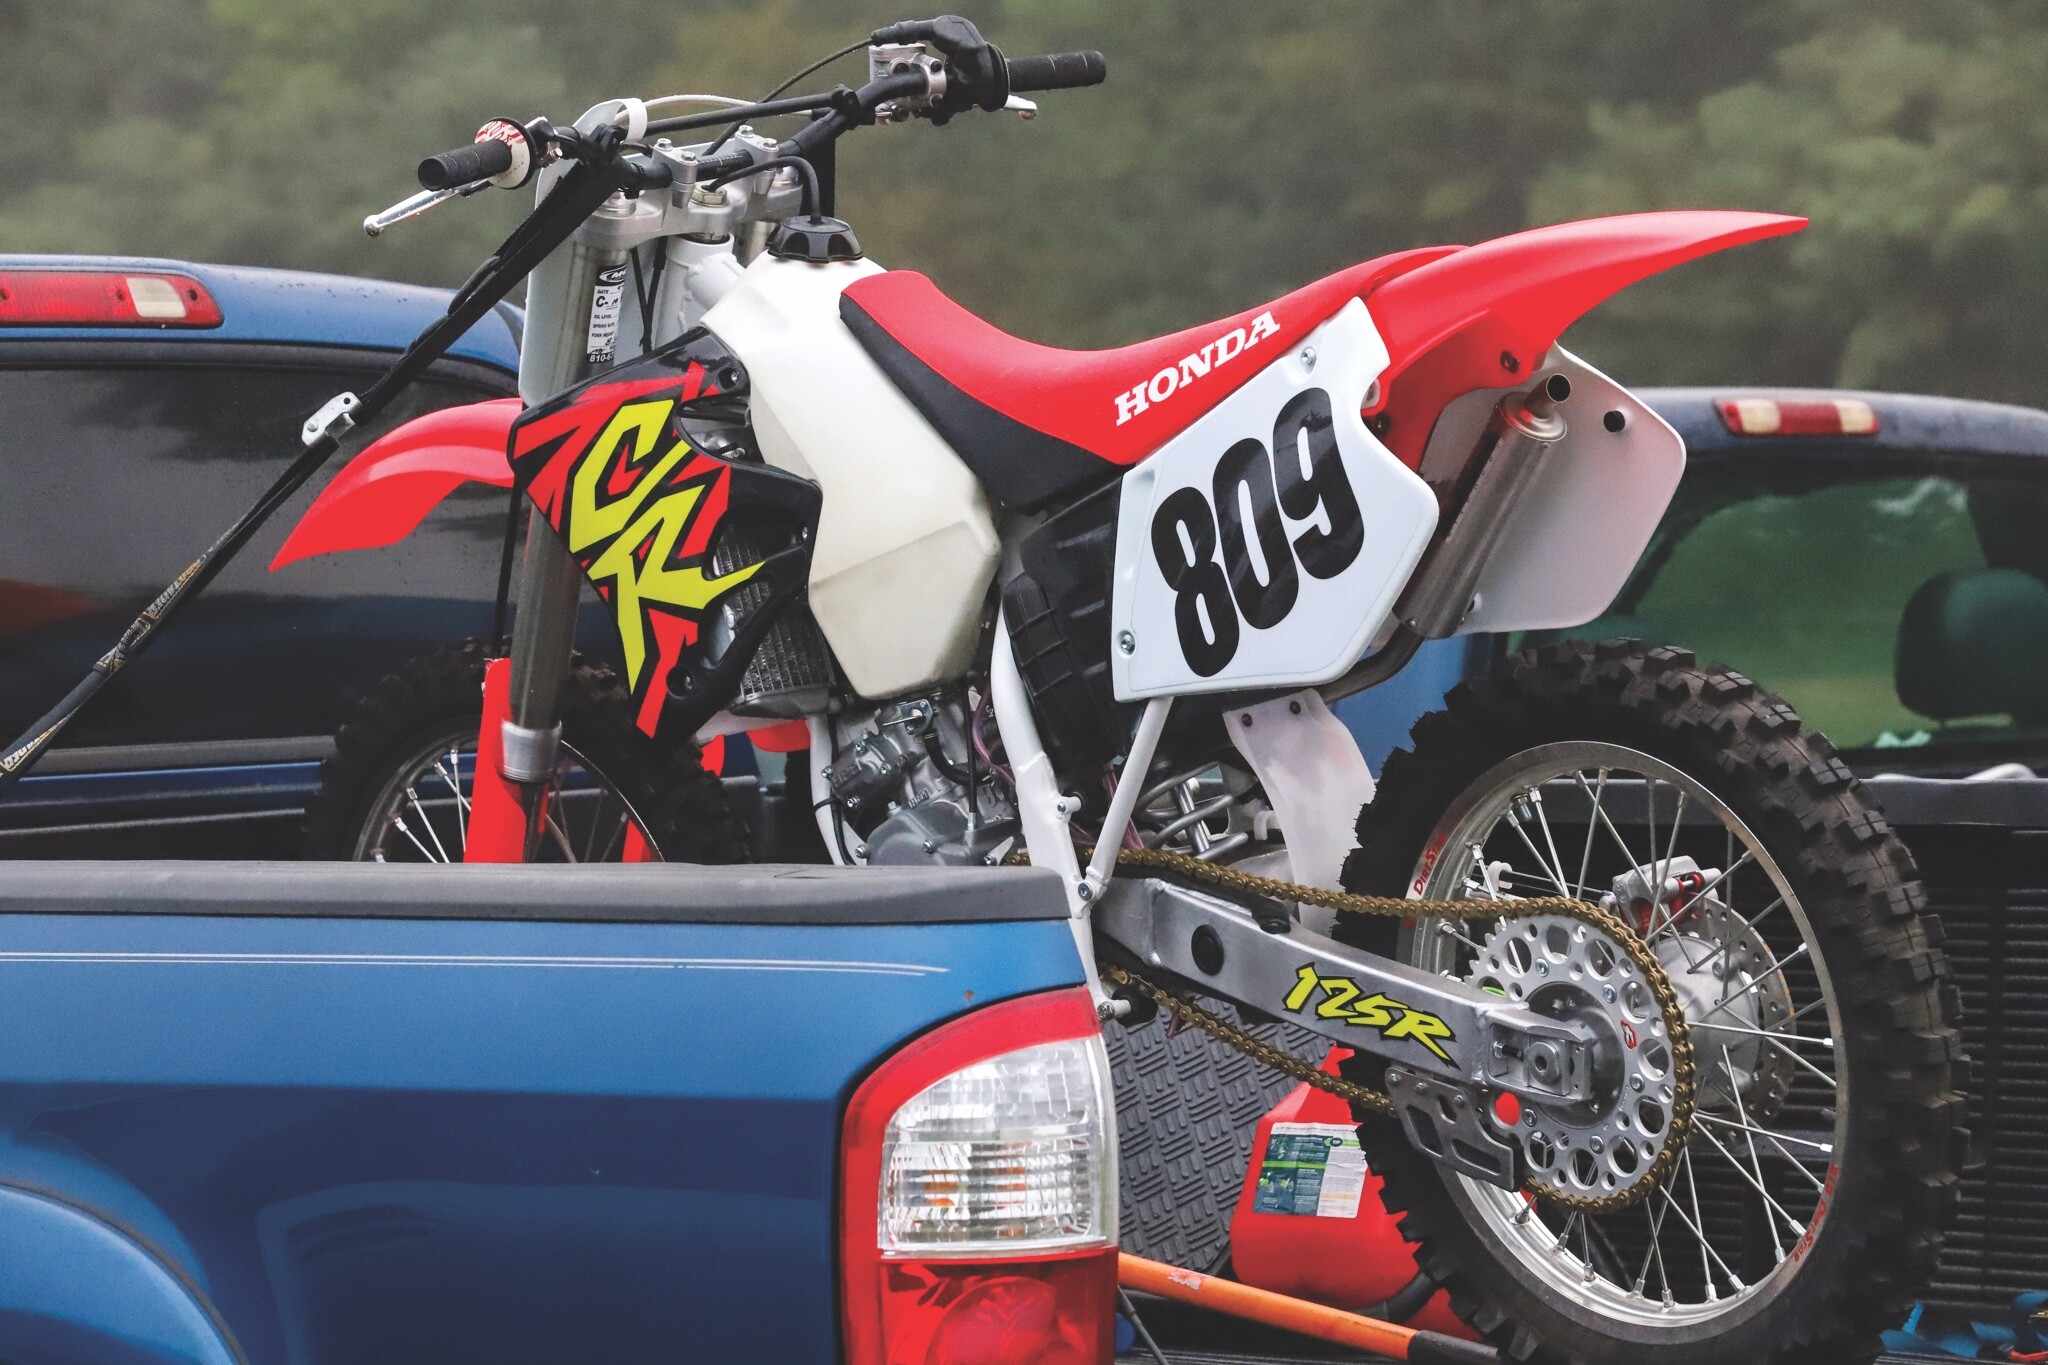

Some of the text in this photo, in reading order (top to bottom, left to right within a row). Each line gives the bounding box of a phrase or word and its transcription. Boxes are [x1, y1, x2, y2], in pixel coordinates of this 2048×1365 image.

[1114, 311, 1280, 426] HONDA
[570, 400, 766, 694] CR
[1151, 387, 1364, 678] 809
[1282, 962, 1460, 1069] 125R
